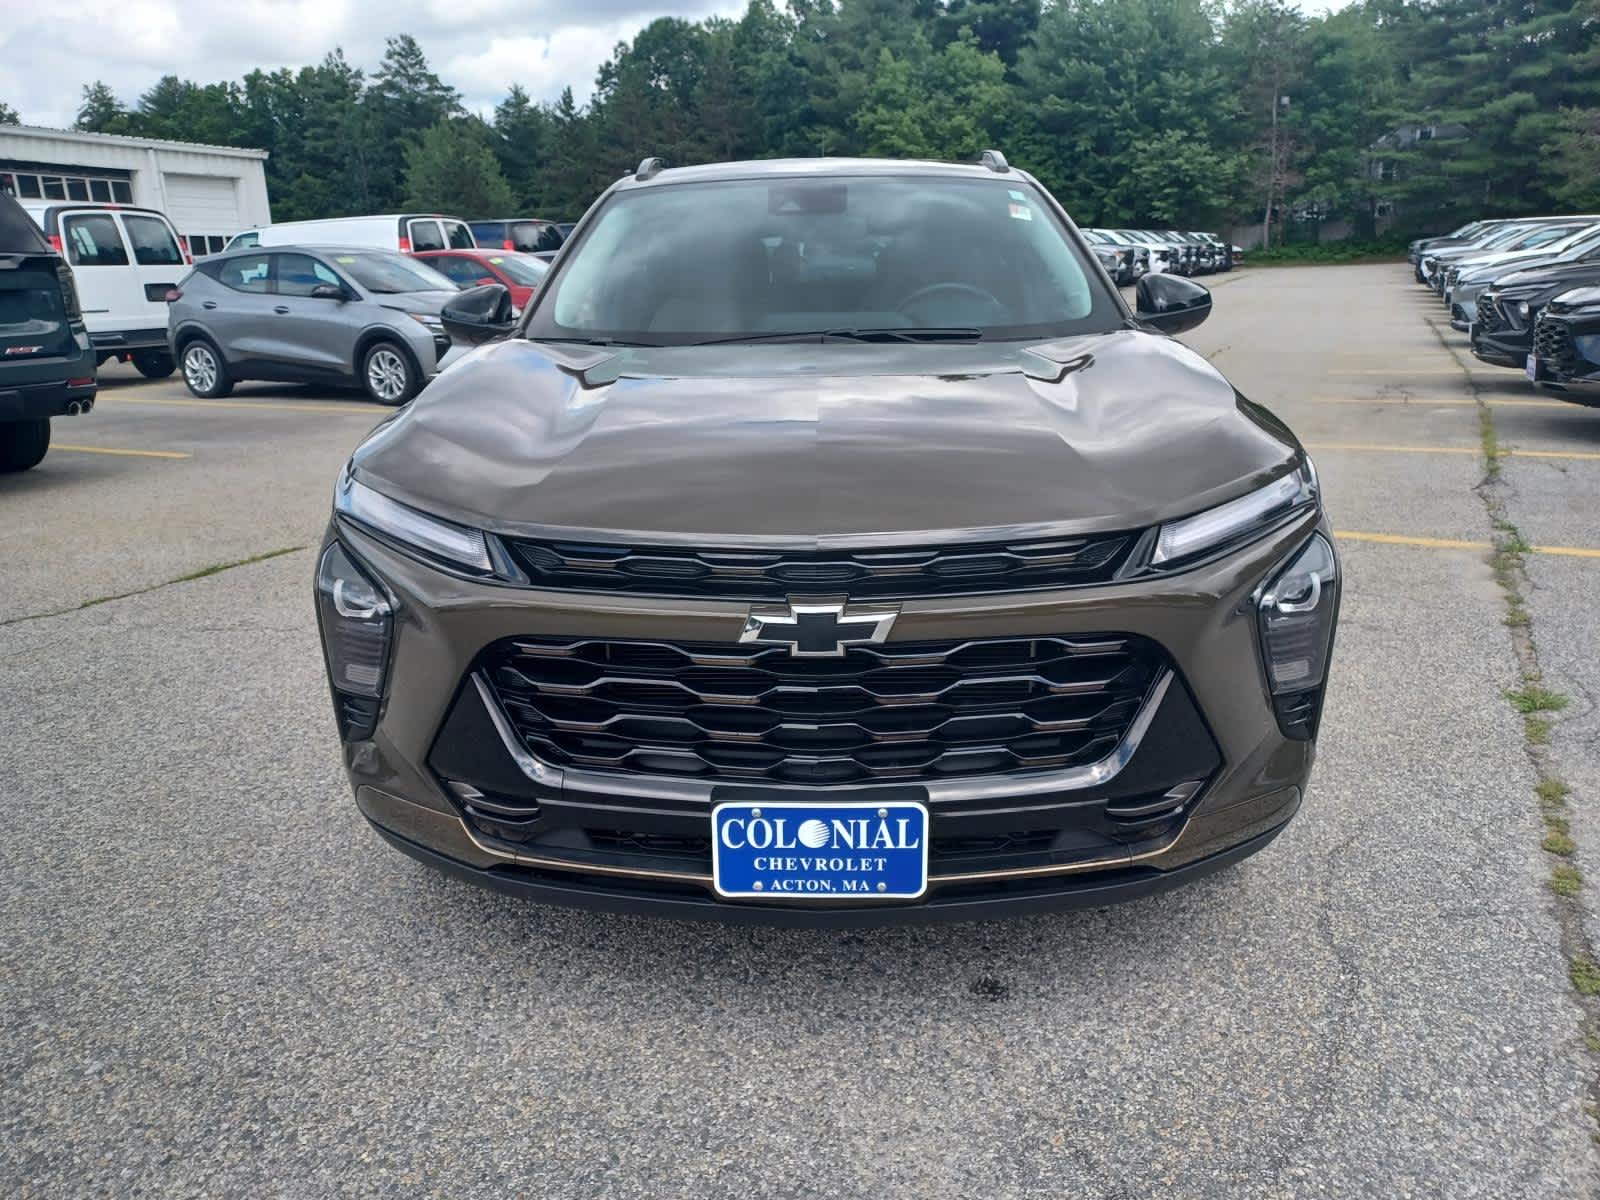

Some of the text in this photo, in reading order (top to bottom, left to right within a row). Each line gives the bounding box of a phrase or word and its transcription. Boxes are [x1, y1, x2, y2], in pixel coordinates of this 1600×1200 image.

[721, 818, 919, 849] COLONIAL
[753, 857, 887, 871] CHEVROLET
[770, 879, 870, 892] ACTON, MA
